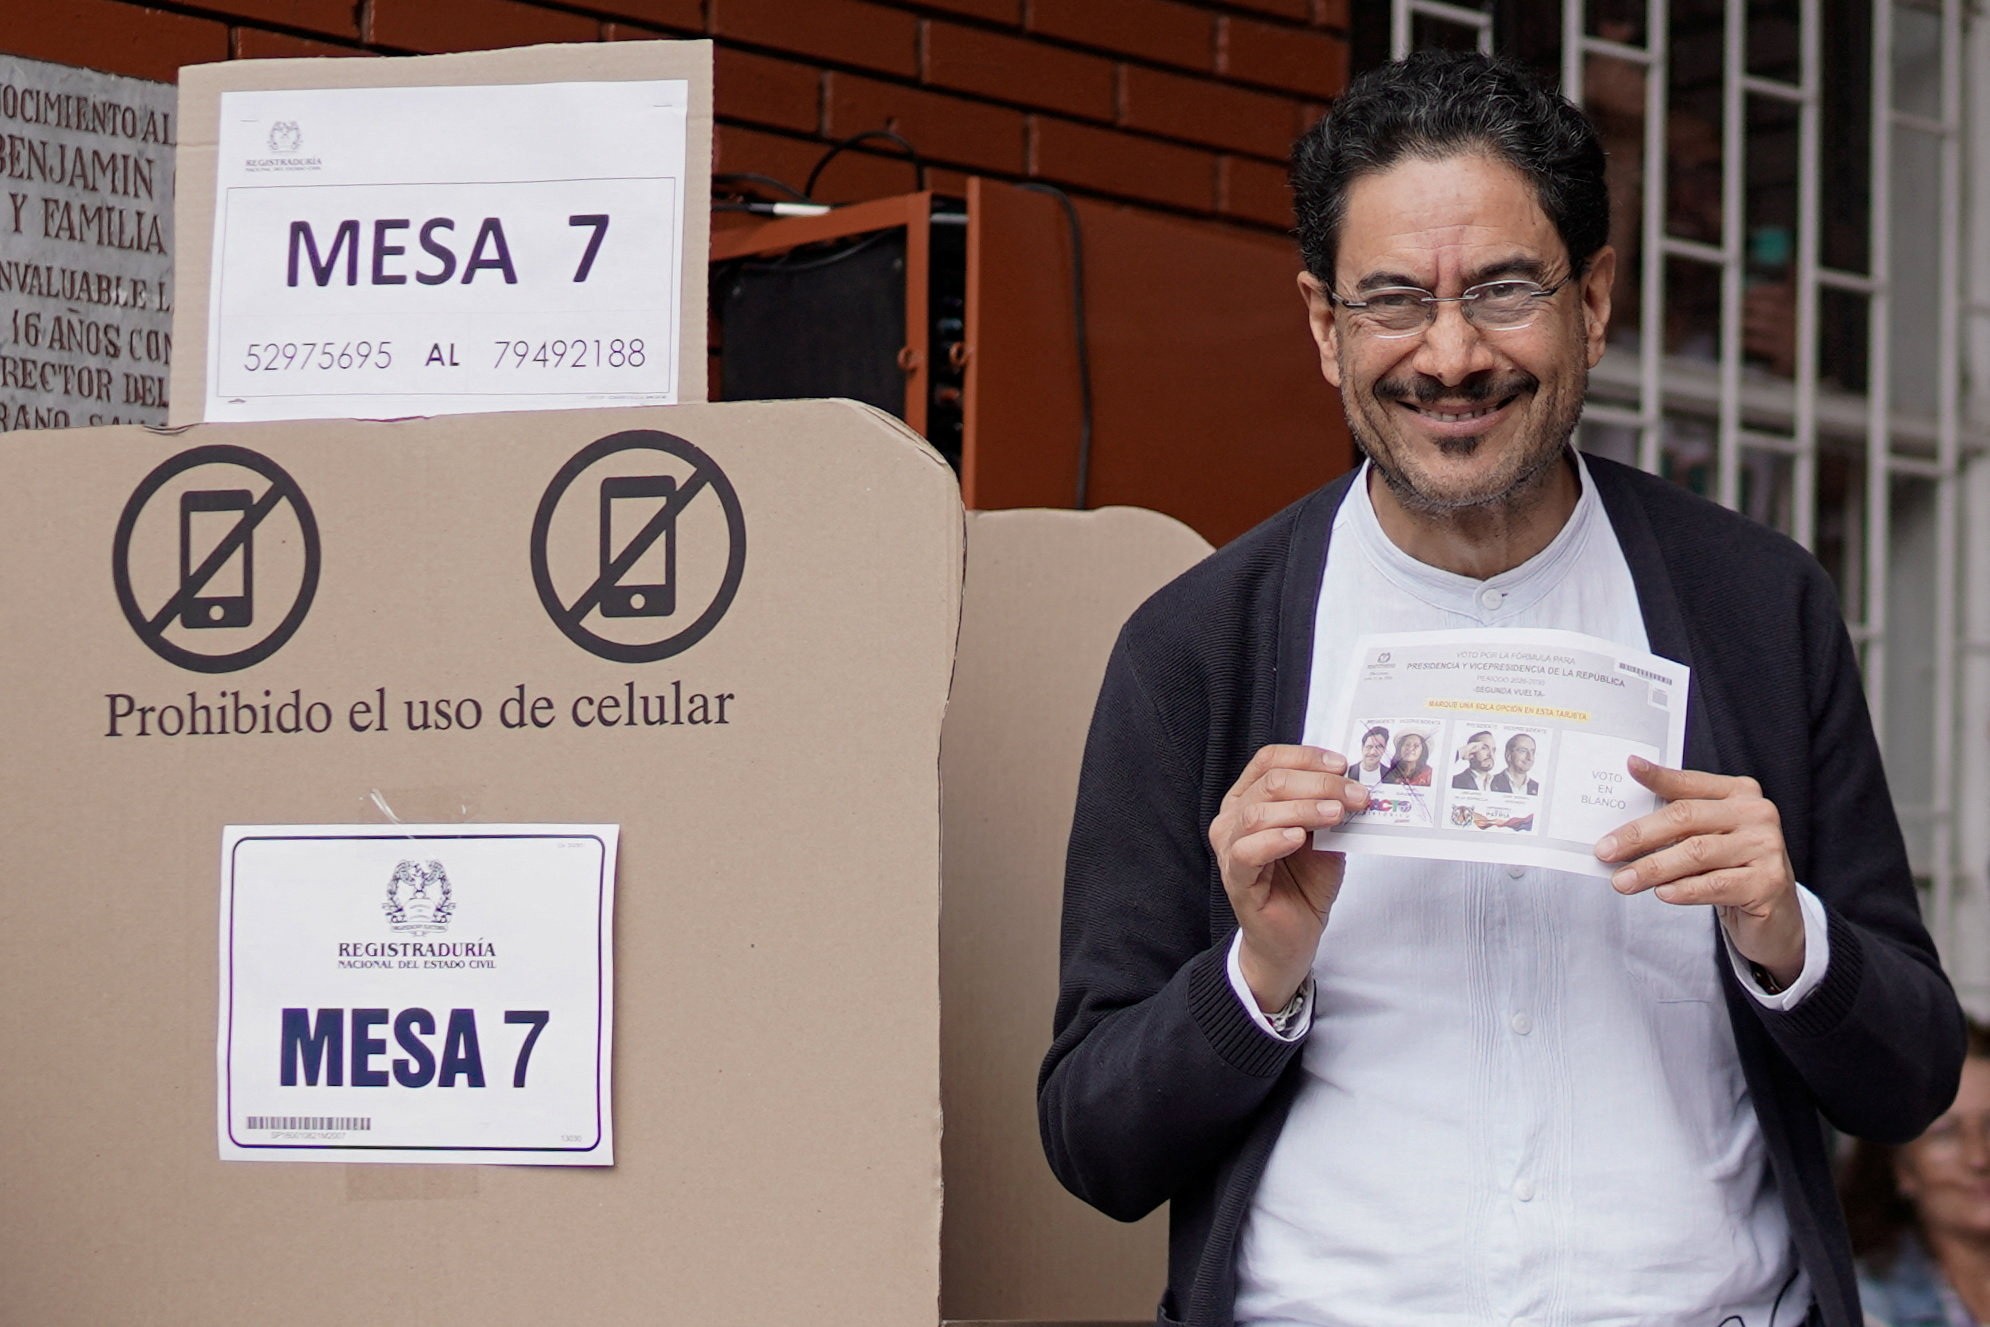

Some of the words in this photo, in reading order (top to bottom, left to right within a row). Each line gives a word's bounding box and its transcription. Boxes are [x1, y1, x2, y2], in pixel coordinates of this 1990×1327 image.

[0, 84, 136, 138] OCIMIENTO
[141, 110, 177, 147] AL
[9, 191, 28, 234] Y
[41, 197, 167, 257] FAMILIA
[286, 217, 518, 287] MESA
[568, 213, 610, 283] 7
[12, 308, 41, 348] 16
[48, 306, 121, 359] AÑOS
[244, 341, 393, 372] 52975695
[425, 342, 460, 367] AL
[494, 338, 647, 369] 79492188
[0, 355, 113, 403] RECTOR
[123, 371, 169, 408] DEL
[1457, 650, 1479, 659] VOTO
[1553, 655, 1576, 664] PARA
[1407, 662, 1460, 670] PRESIDENCIA
[1469, 662, 1546, 674] VICEPRESIDENCIA
[1548, 666, 1560, 676] DE
[1562, 668, 1574, 678] LA
[104, 689, 332, 737] Prohibido
[348, 687, 389, 732] el
[406, 695, 483, 731] uso
[500, 684, 555, 729] de
[571, 681, 735, 728] celular
[1429, 700, 1457, 708] MARQUE
[1536, 707, 1554, 716] ESTA
[1556, 709, 1587, 720] TARJETA
[1592, 770, 1623, 783] VOTO
[1598, 784, 1613, 794] EN
[1367, 799, 1411, 813] ACTO
[1581, 794, 1626, 810] BLANCO
[338, 938, 497, 957] REGISTRADURÍA
[338, 960, 394, 969] NACIONAL
[398, 960, 419, 969] DEL
[424, 960, 466, 969] ESTADO
[469, 960, 497, 969] CIVIL
[280, 1007, 486, 1088] MESA
[503, 1010, 550, 1088] 7
